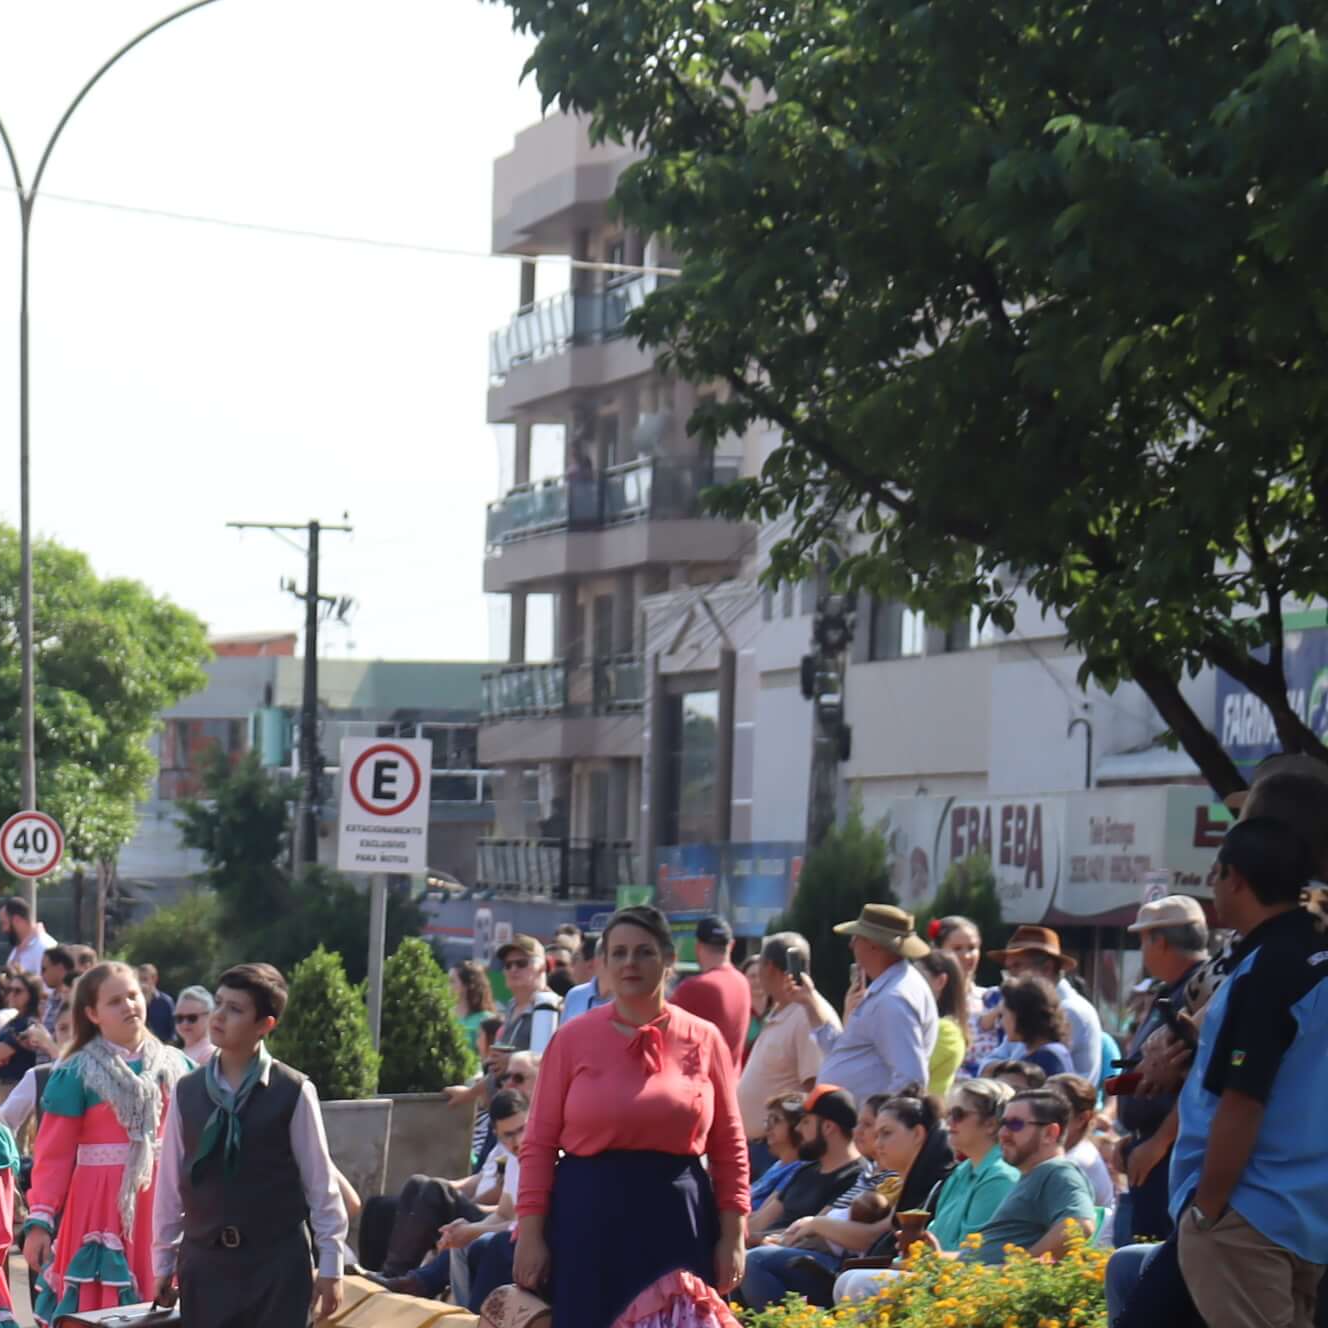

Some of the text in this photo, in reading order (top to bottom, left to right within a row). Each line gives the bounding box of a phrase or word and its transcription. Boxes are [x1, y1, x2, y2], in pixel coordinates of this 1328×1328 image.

[372, 760, 399, 800] E
[13, 827, 48, 853] 40
[1000, 804, 1043, 889] EBA
